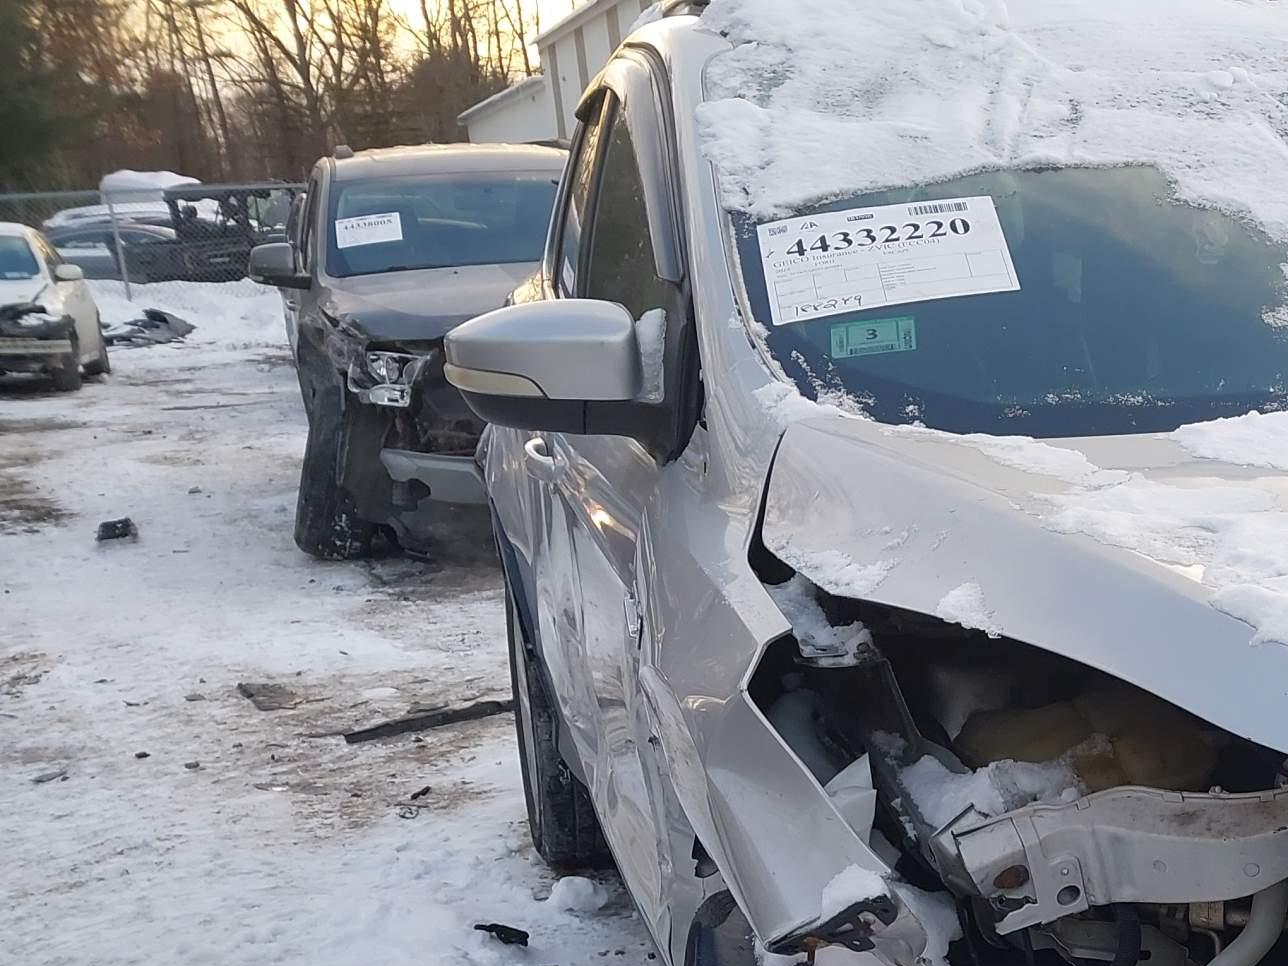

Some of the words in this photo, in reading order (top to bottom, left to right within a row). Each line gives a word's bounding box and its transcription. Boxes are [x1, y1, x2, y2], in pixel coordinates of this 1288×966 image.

[786, 217, 971, 257] 44332220
[773, 256, 810, 268] GEICO
[811, 249, 858, 262] Insurance
[865, 328, 879, 340] 3
